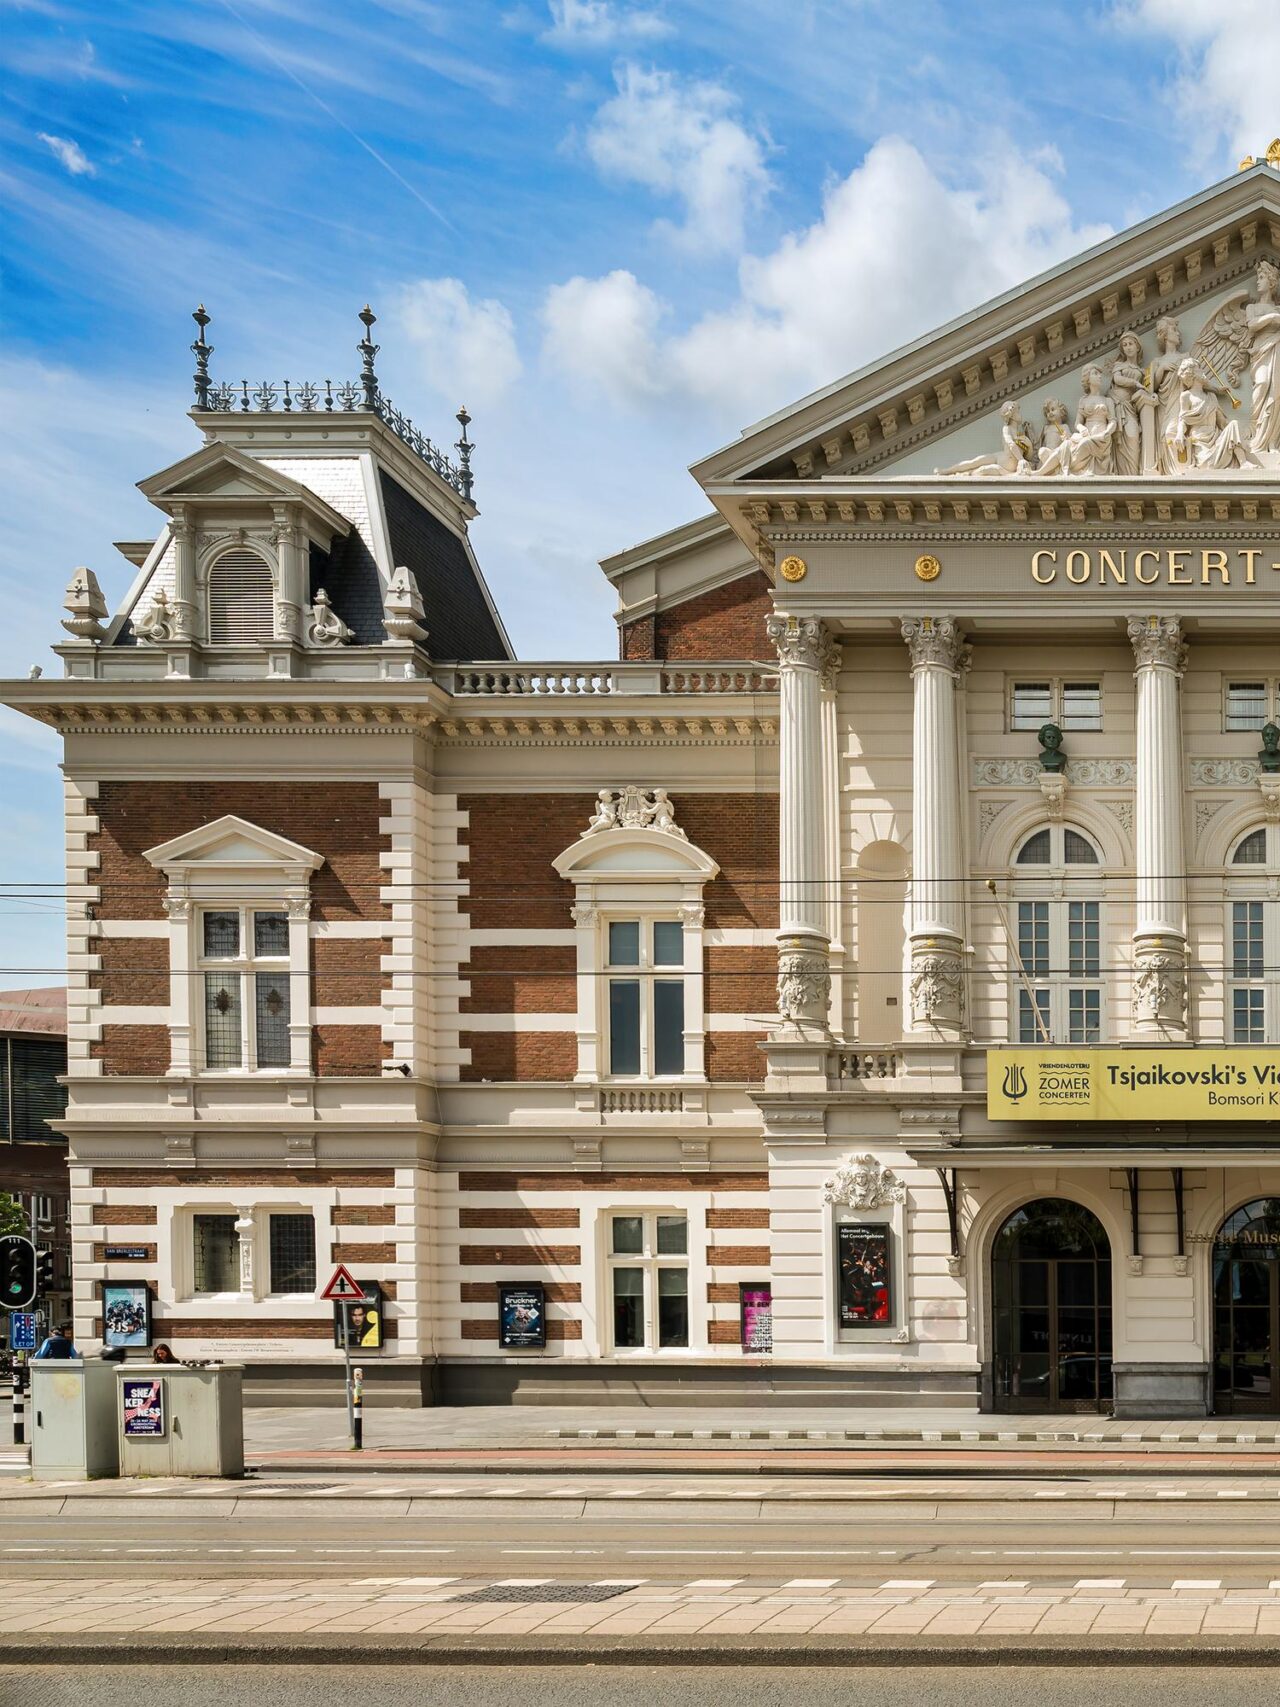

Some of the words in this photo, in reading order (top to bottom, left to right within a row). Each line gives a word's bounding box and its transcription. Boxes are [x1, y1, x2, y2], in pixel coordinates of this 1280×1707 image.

[1107, 1063, 1247, 1091] Tsjaikovski's
[1039, 1077, 1090, 1090] ZOMER
[1039, 1091, 1090, 1099] CONCERTEN
[1208, 1091, 1264, 1106] Bomsori
[109, 1321, 129, 1333] 3JS
[130, 1387, 154, 1398] SNEA
[137, 1407, 161, 1417] NESS
